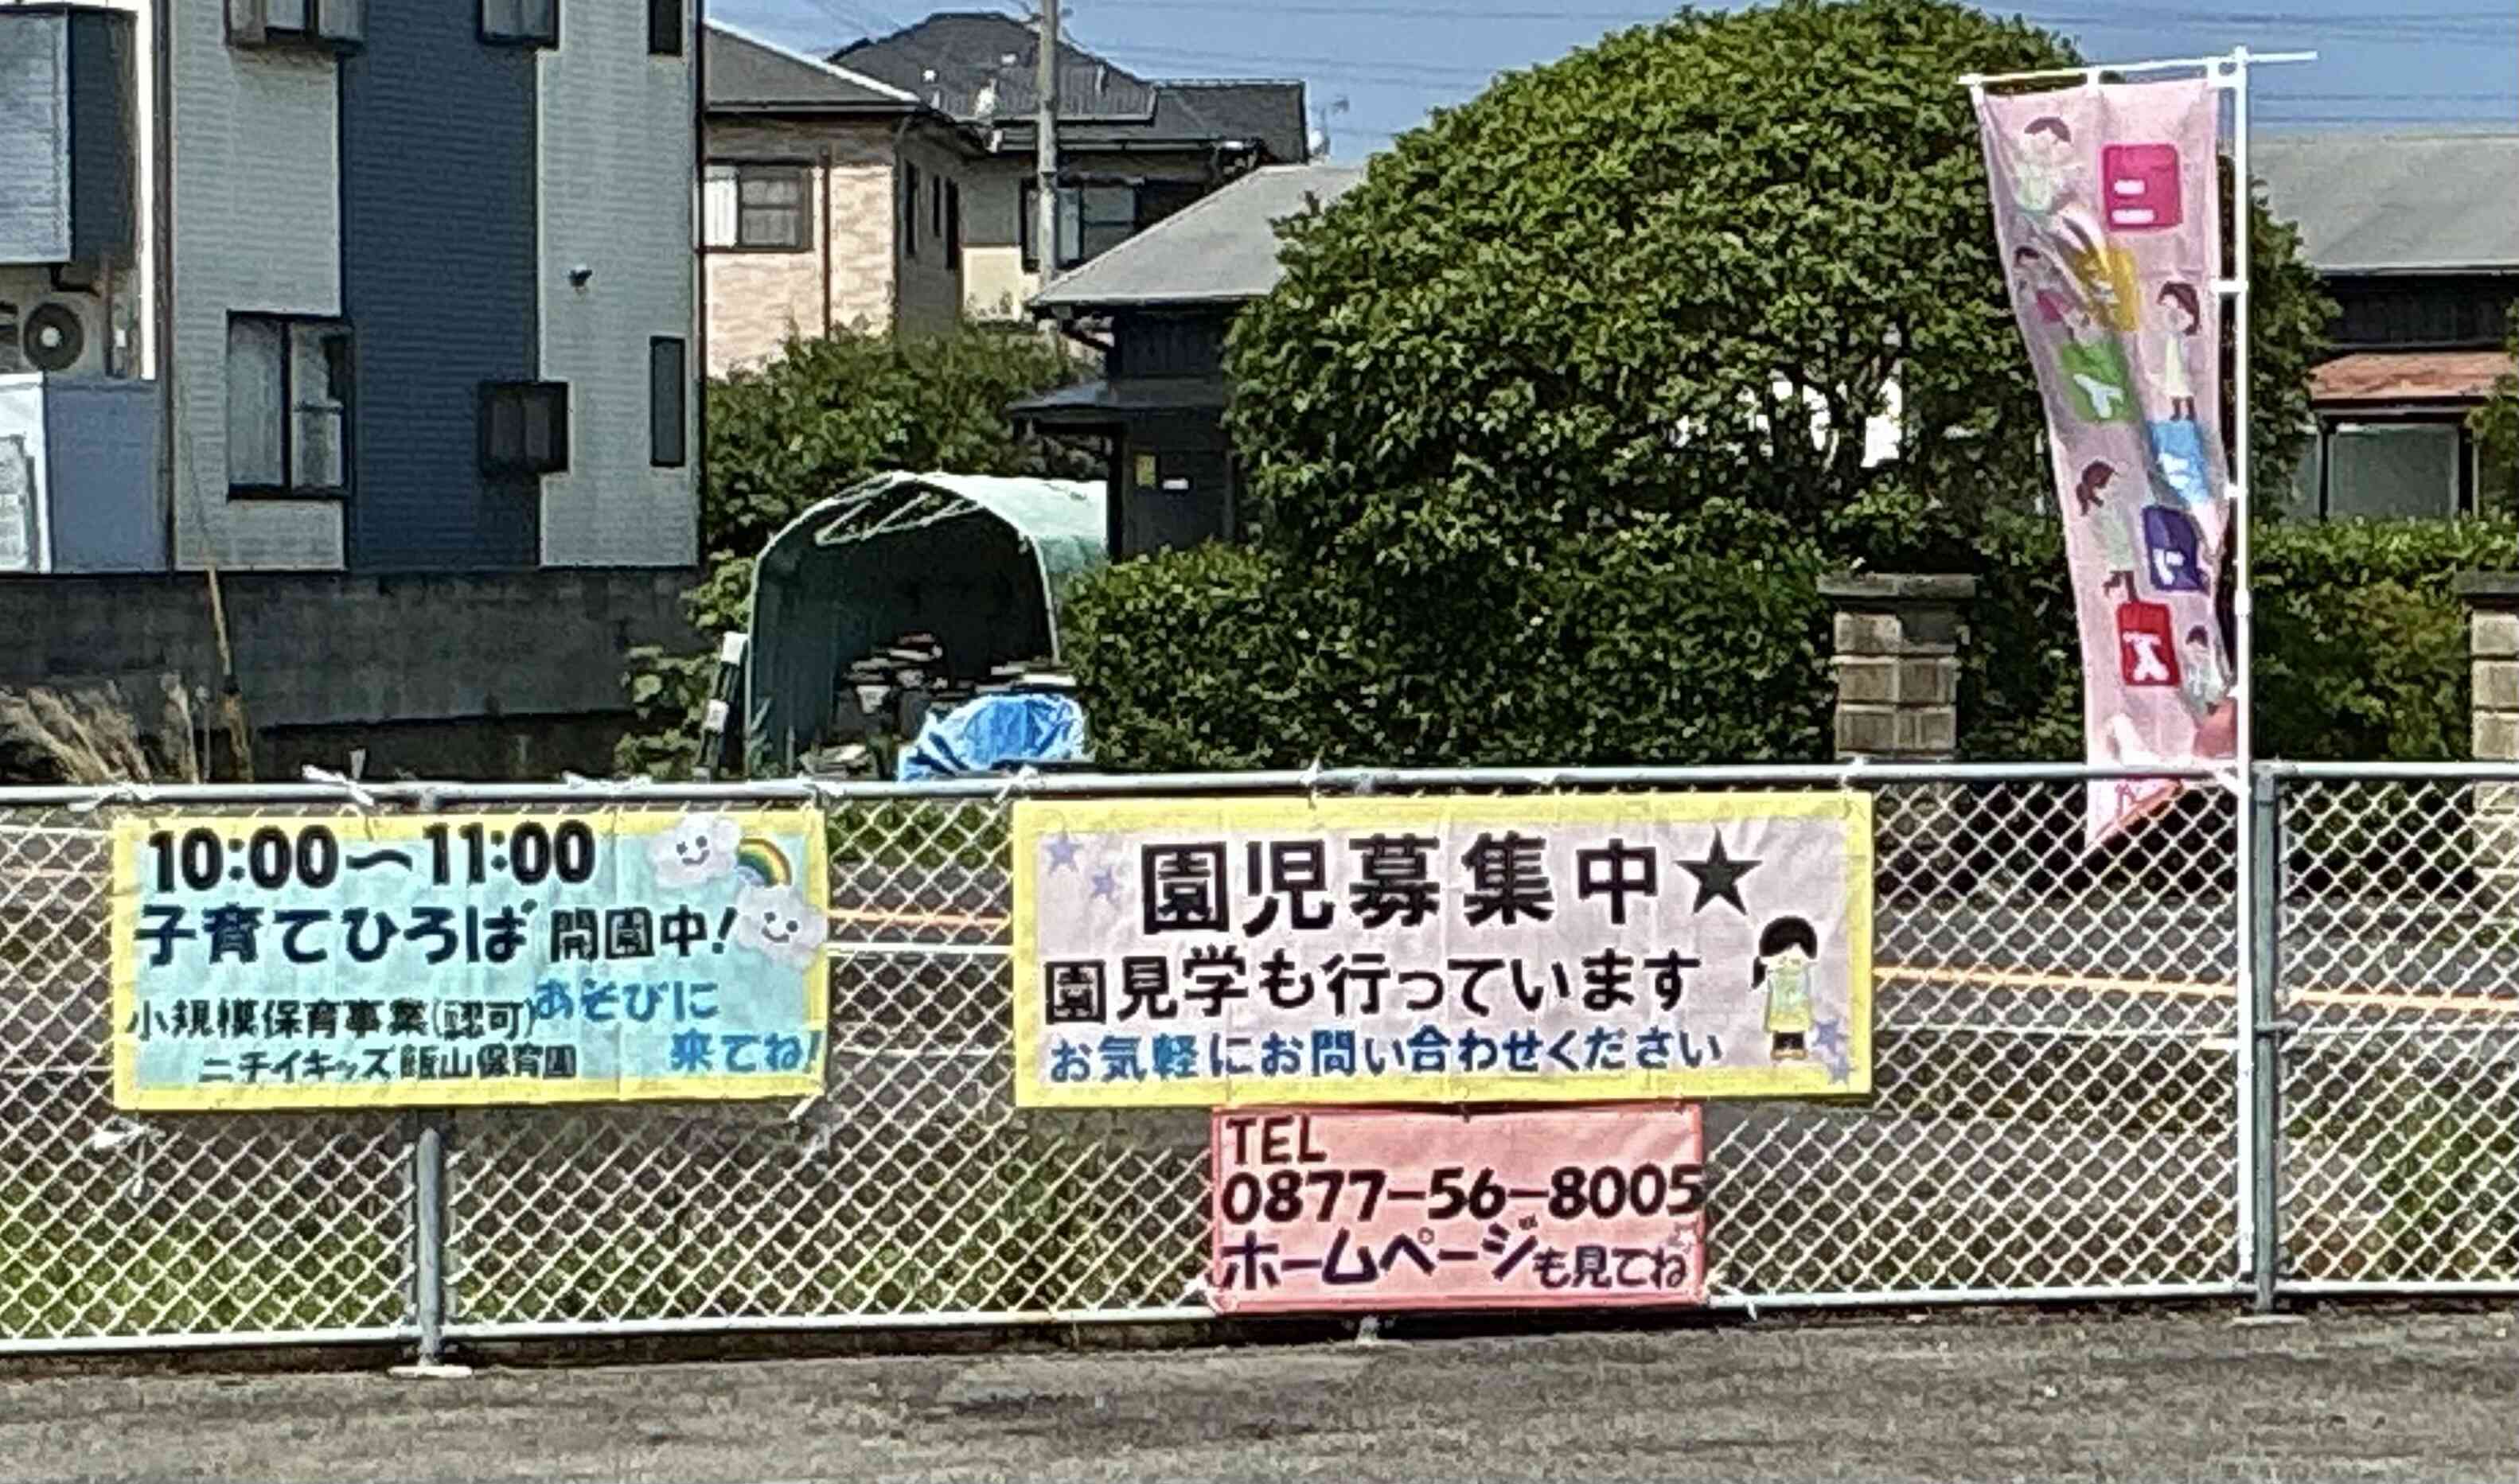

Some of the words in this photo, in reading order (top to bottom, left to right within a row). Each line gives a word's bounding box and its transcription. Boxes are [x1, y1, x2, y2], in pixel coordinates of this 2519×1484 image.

[535, 978, 720, 1023] あそびに
[1044, 944, 1702, 1025] 園見学も行っています
[1049, 1025, 1722, 1083] お気軽にお問い合わせください
[1226, 1116, 1327, 1163] TEL
